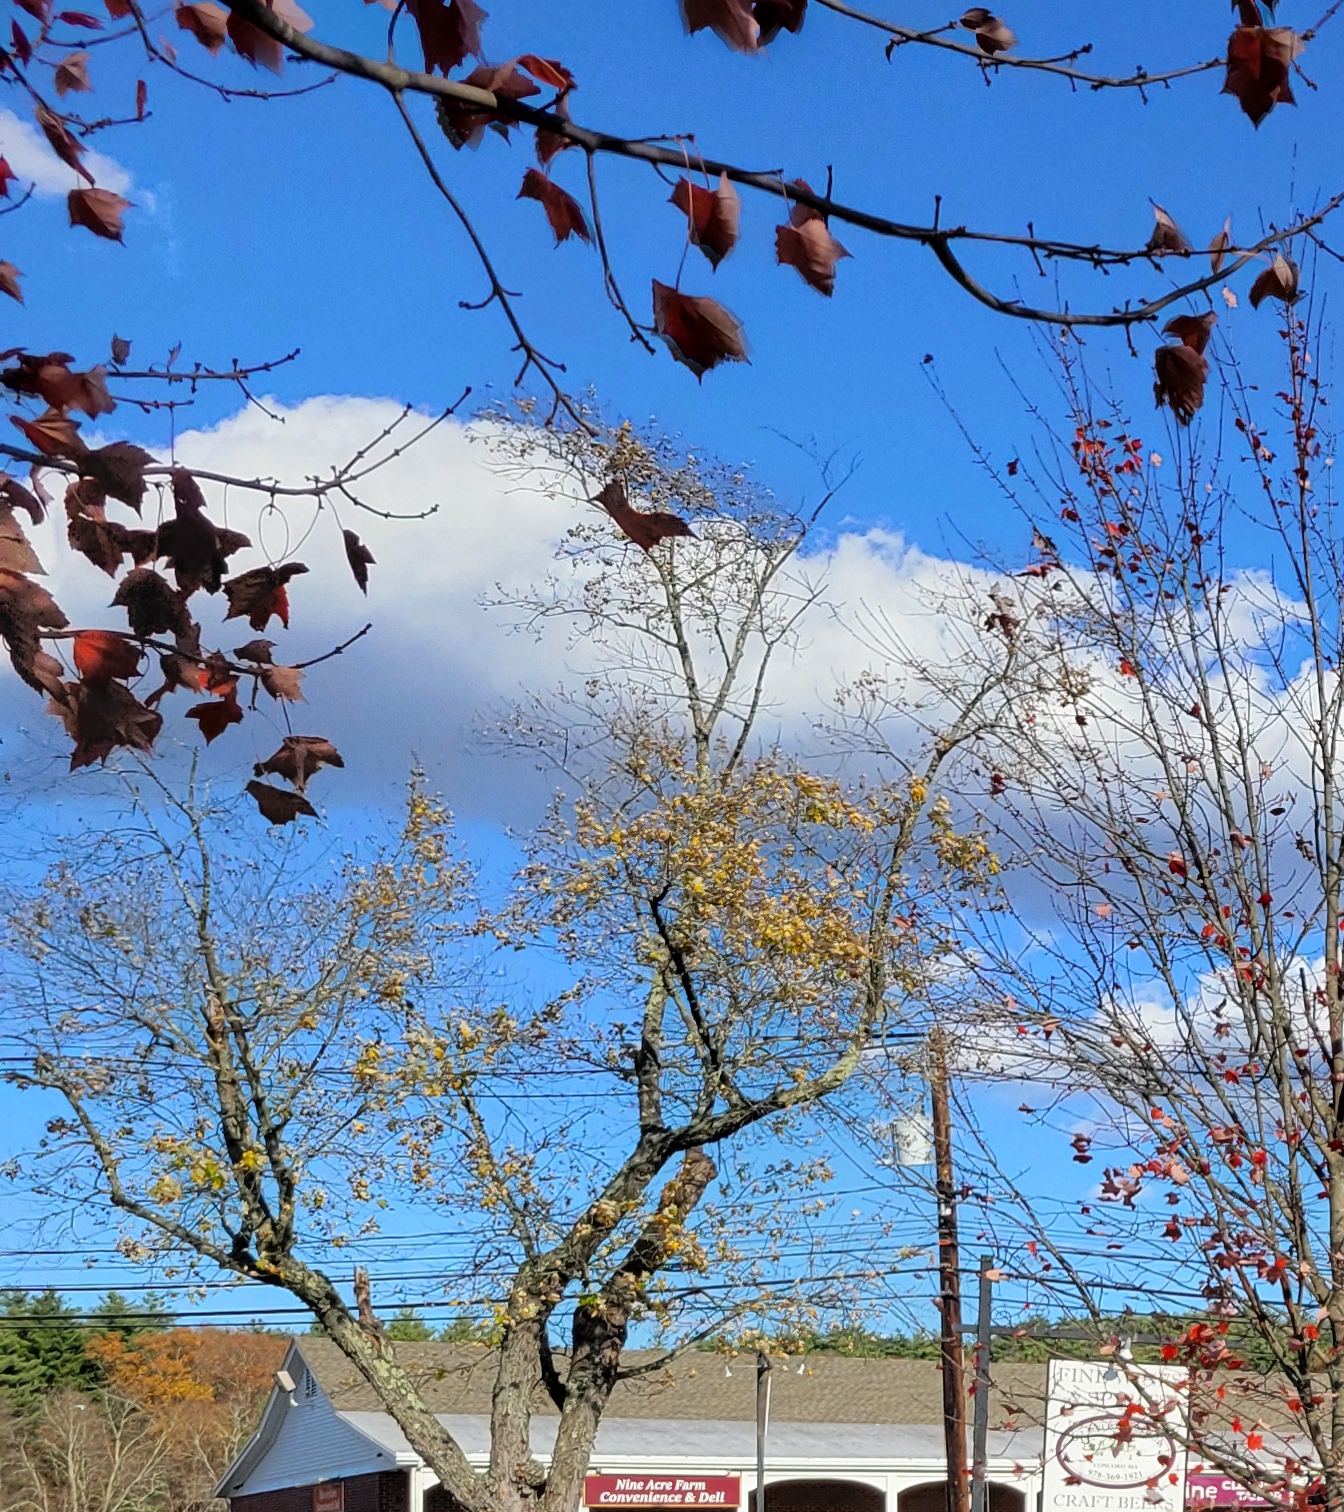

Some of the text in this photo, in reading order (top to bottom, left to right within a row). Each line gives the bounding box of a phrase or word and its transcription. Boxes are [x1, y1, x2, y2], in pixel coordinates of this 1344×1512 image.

[1088, 1469, 1143, 1481] 978-369-1921
[615, 1478, 707, 1491] Nine Acre Farm
[599, 1491, 726, 1503] Convenience & Deli
[1053, 1494, 1115, 1508] CRAFT
